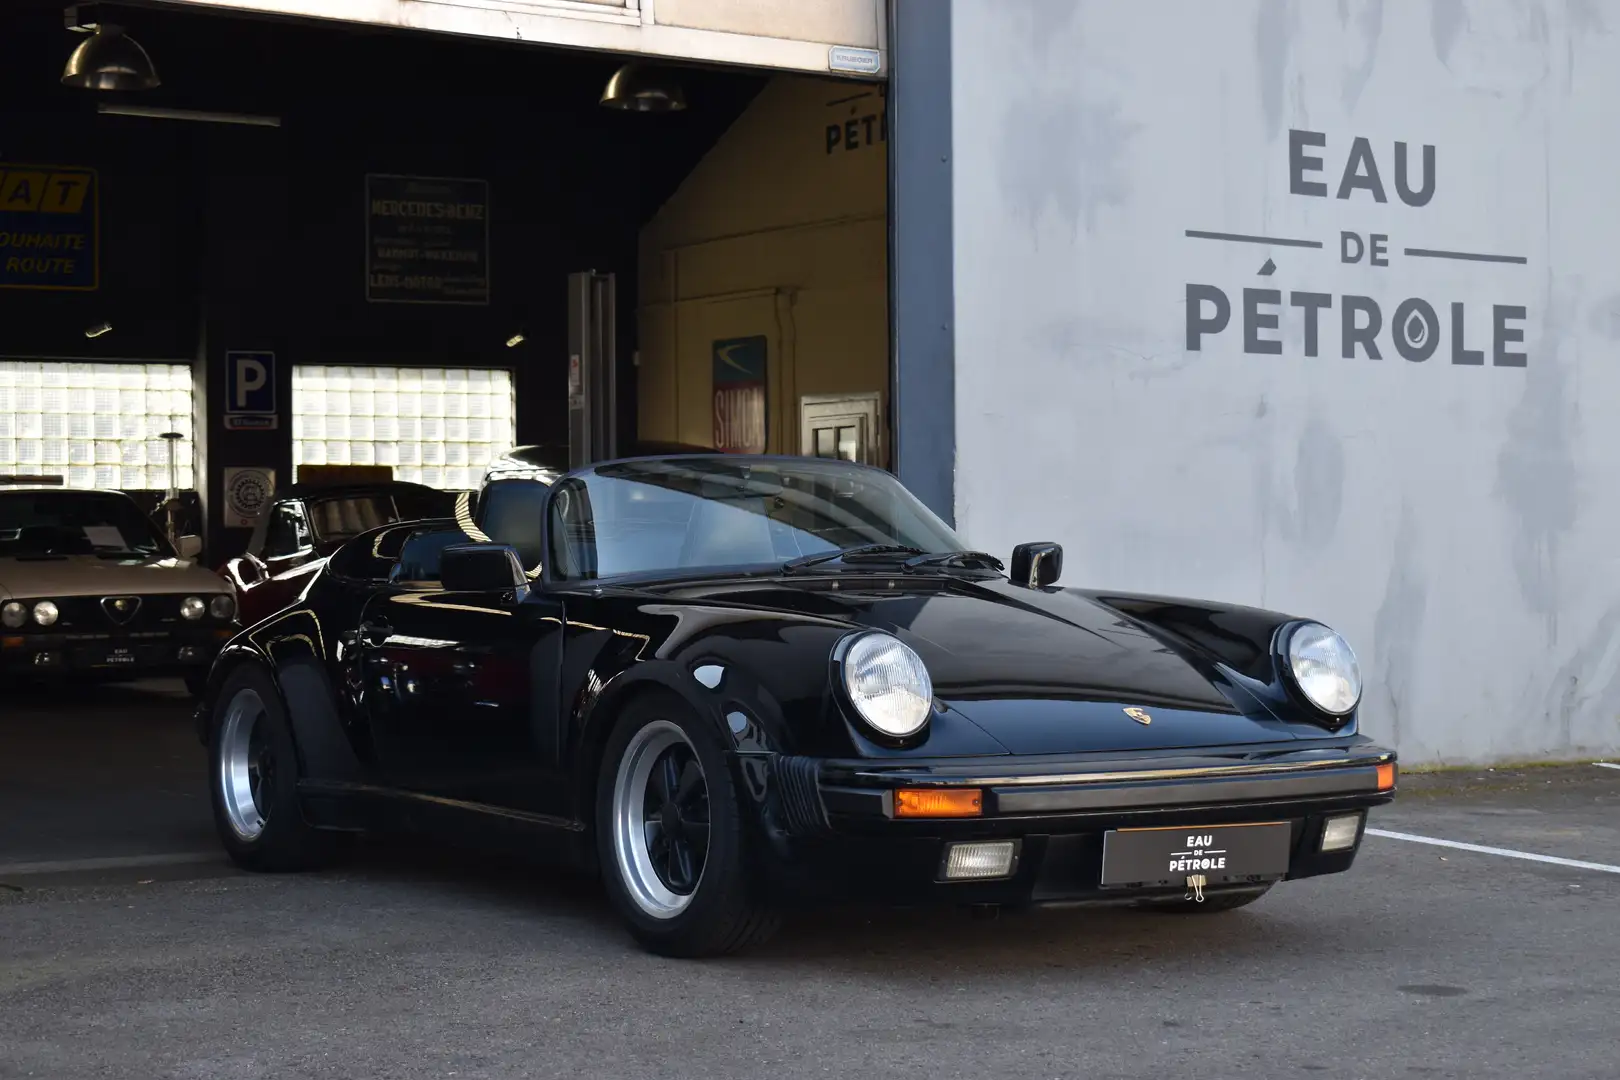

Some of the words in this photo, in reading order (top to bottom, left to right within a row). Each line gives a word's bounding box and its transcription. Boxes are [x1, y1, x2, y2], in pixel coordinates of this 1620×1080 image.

[1289, 129, 1436, 207] EAU
[6, 256, 76, 275] ROUTE
[1340, 231, 1389, 266] DE
[1186, 258, 1527, 368] PÉTROLE
[237, 359, 267, 407] P
[1186, 835, 1213, 847] EAU
[1169, 855, 1226, 872] PÉTROLE
